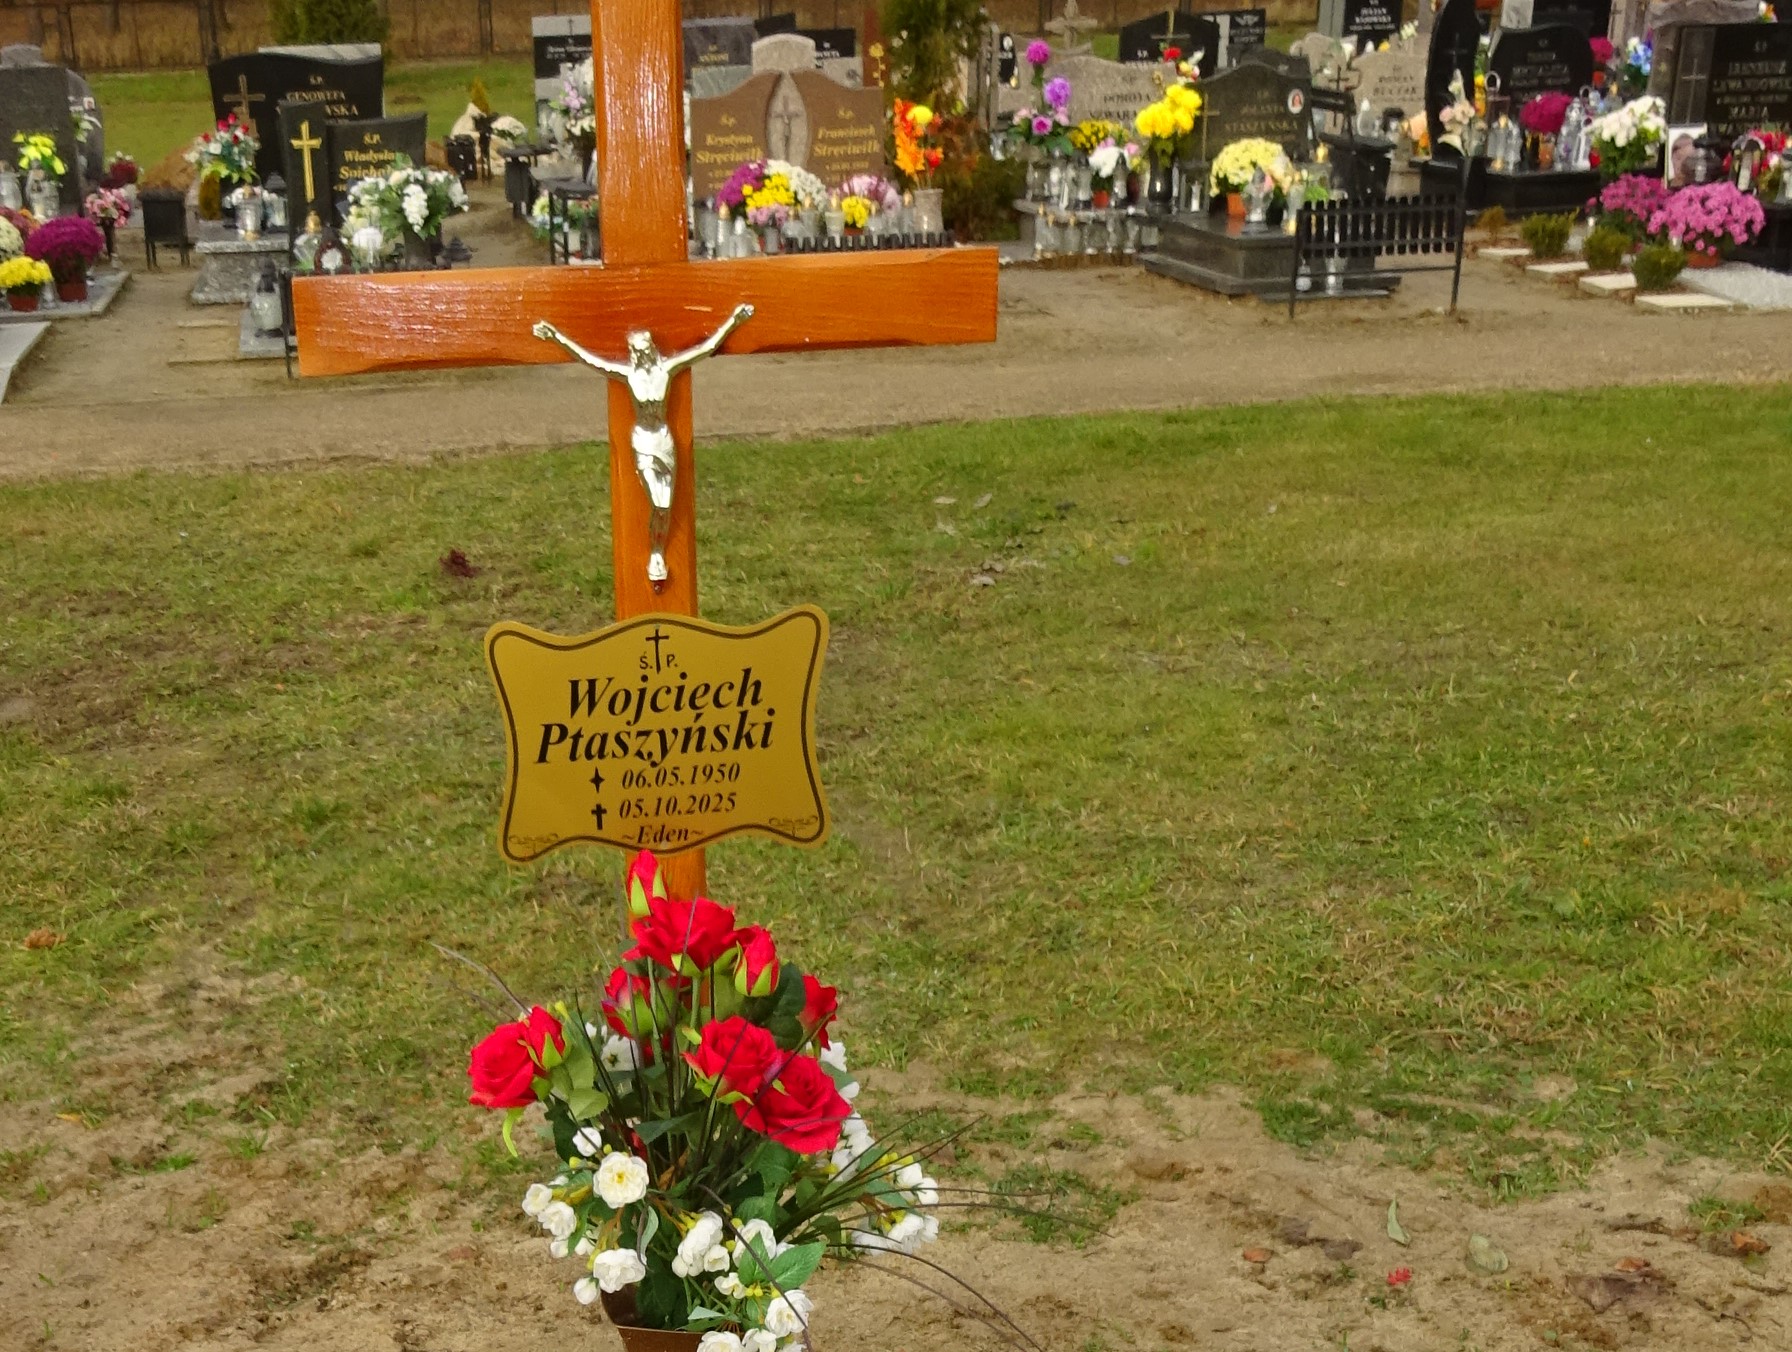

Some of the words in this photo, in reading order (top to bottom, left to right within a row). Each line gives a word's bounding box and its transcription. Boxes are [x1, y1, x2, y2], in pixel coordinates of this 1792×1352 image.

[568, 667, 763, 726] Wojciech
[535, 708, 775, 768] Ptaszyński
[621, 762, 741, 790] 06.05.1950
[619, 792, 737, 819] 05.10.2025
